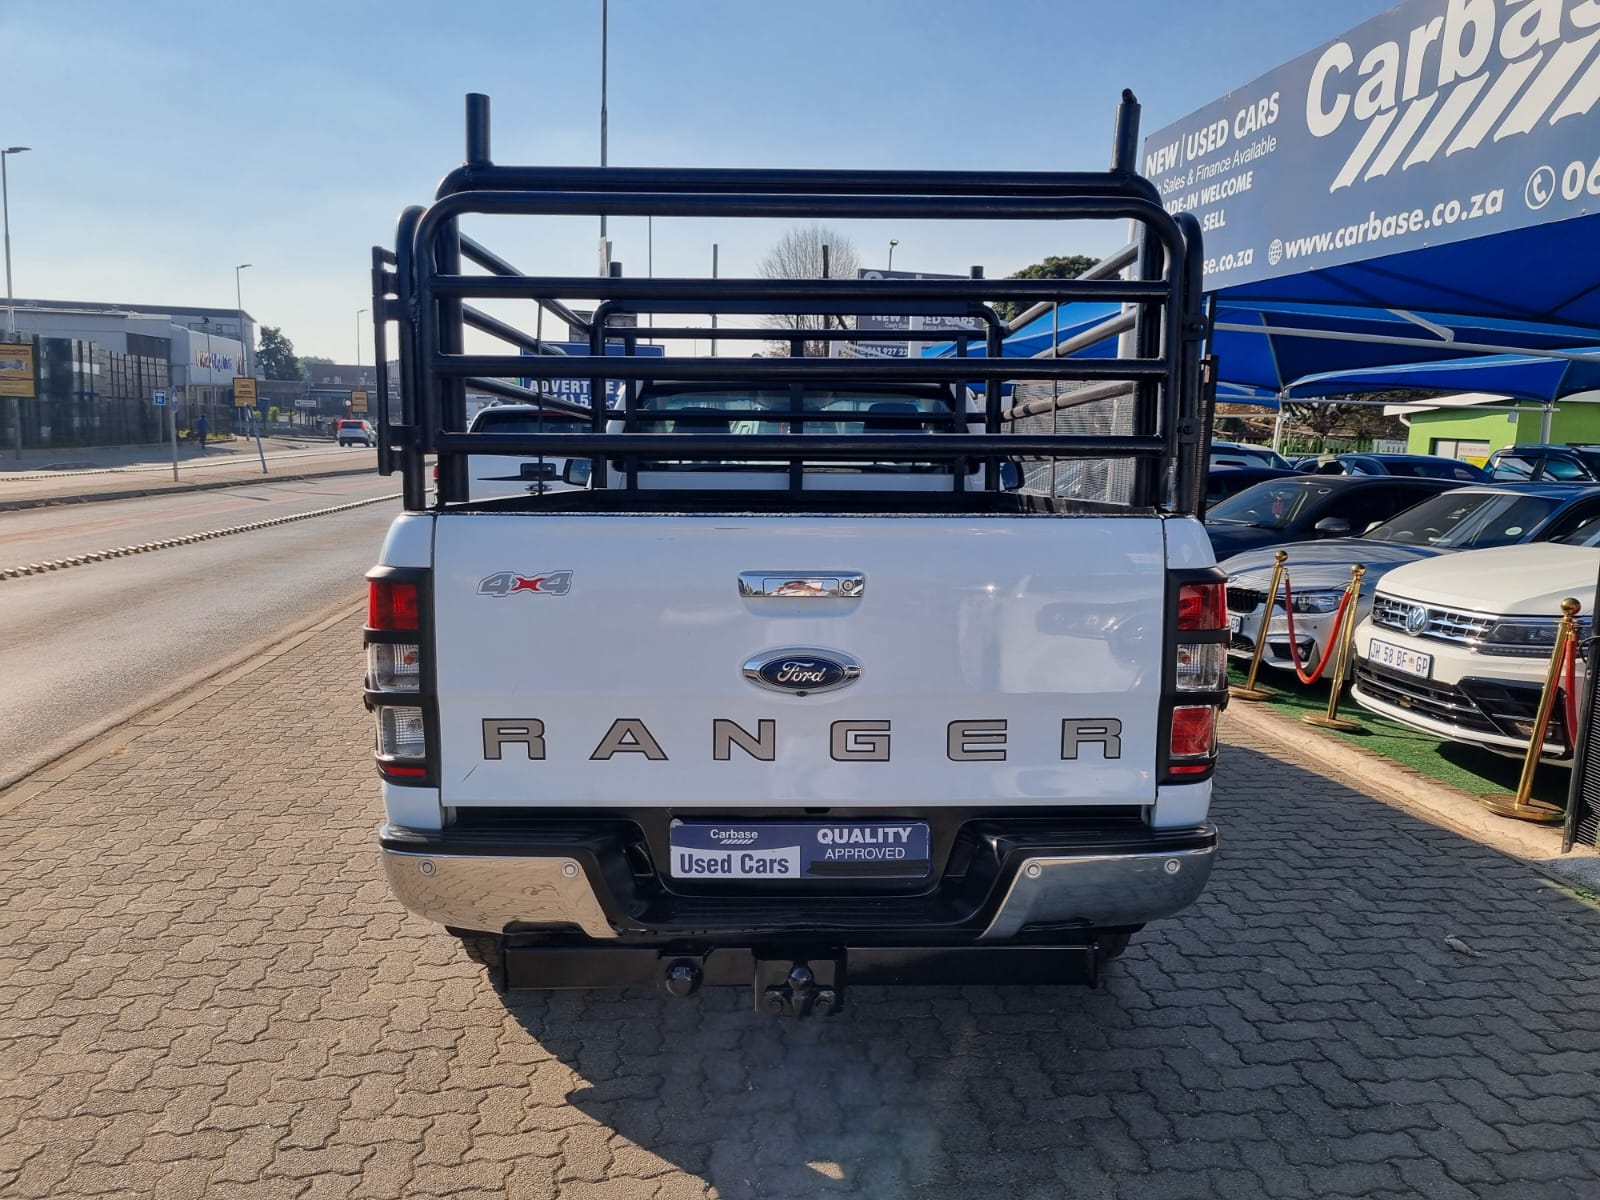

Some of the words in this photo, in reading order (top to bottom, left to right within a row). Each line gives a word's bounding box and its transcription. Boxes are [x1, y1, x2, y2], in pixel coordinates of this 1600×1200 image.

[1306, 0, 1600, 137] Carba
[1145, 141, 1180, 178] NEW
[1186, 118, 1229, 161] USED
[1233, 91, 1280, 140] CARS
[1162, 175, 1186, 195] Sales
[1186, 168, 1194, 186] &
[1195, 156, 1231, 183] Finance
[1231, 134, 1277, 169] Available
[1163, 191, 1199, 216] ADE-IN
[1200, 171, 1254, 206] WELCOME
[1203, 209, 1226, 233] SELL
[1285, 188, 1504, 260] www.carbase.co.za
[1203, 248, 1254, 276] se.co.za
[529, 380, 614, 394] ADVERTE
[777, 661, 826, 682] Ford
[1416, 656, 1428, 673] GP
[482, 718, 1122, 762] RANGER
[710, 829, 758, 839] Carbase
[817, 827, 912, 844] QUALITY
[680, 853, 732, 874] Used
[740, 853, 789, 874] Cars
[824, 847, 905, 860] APPROVED
